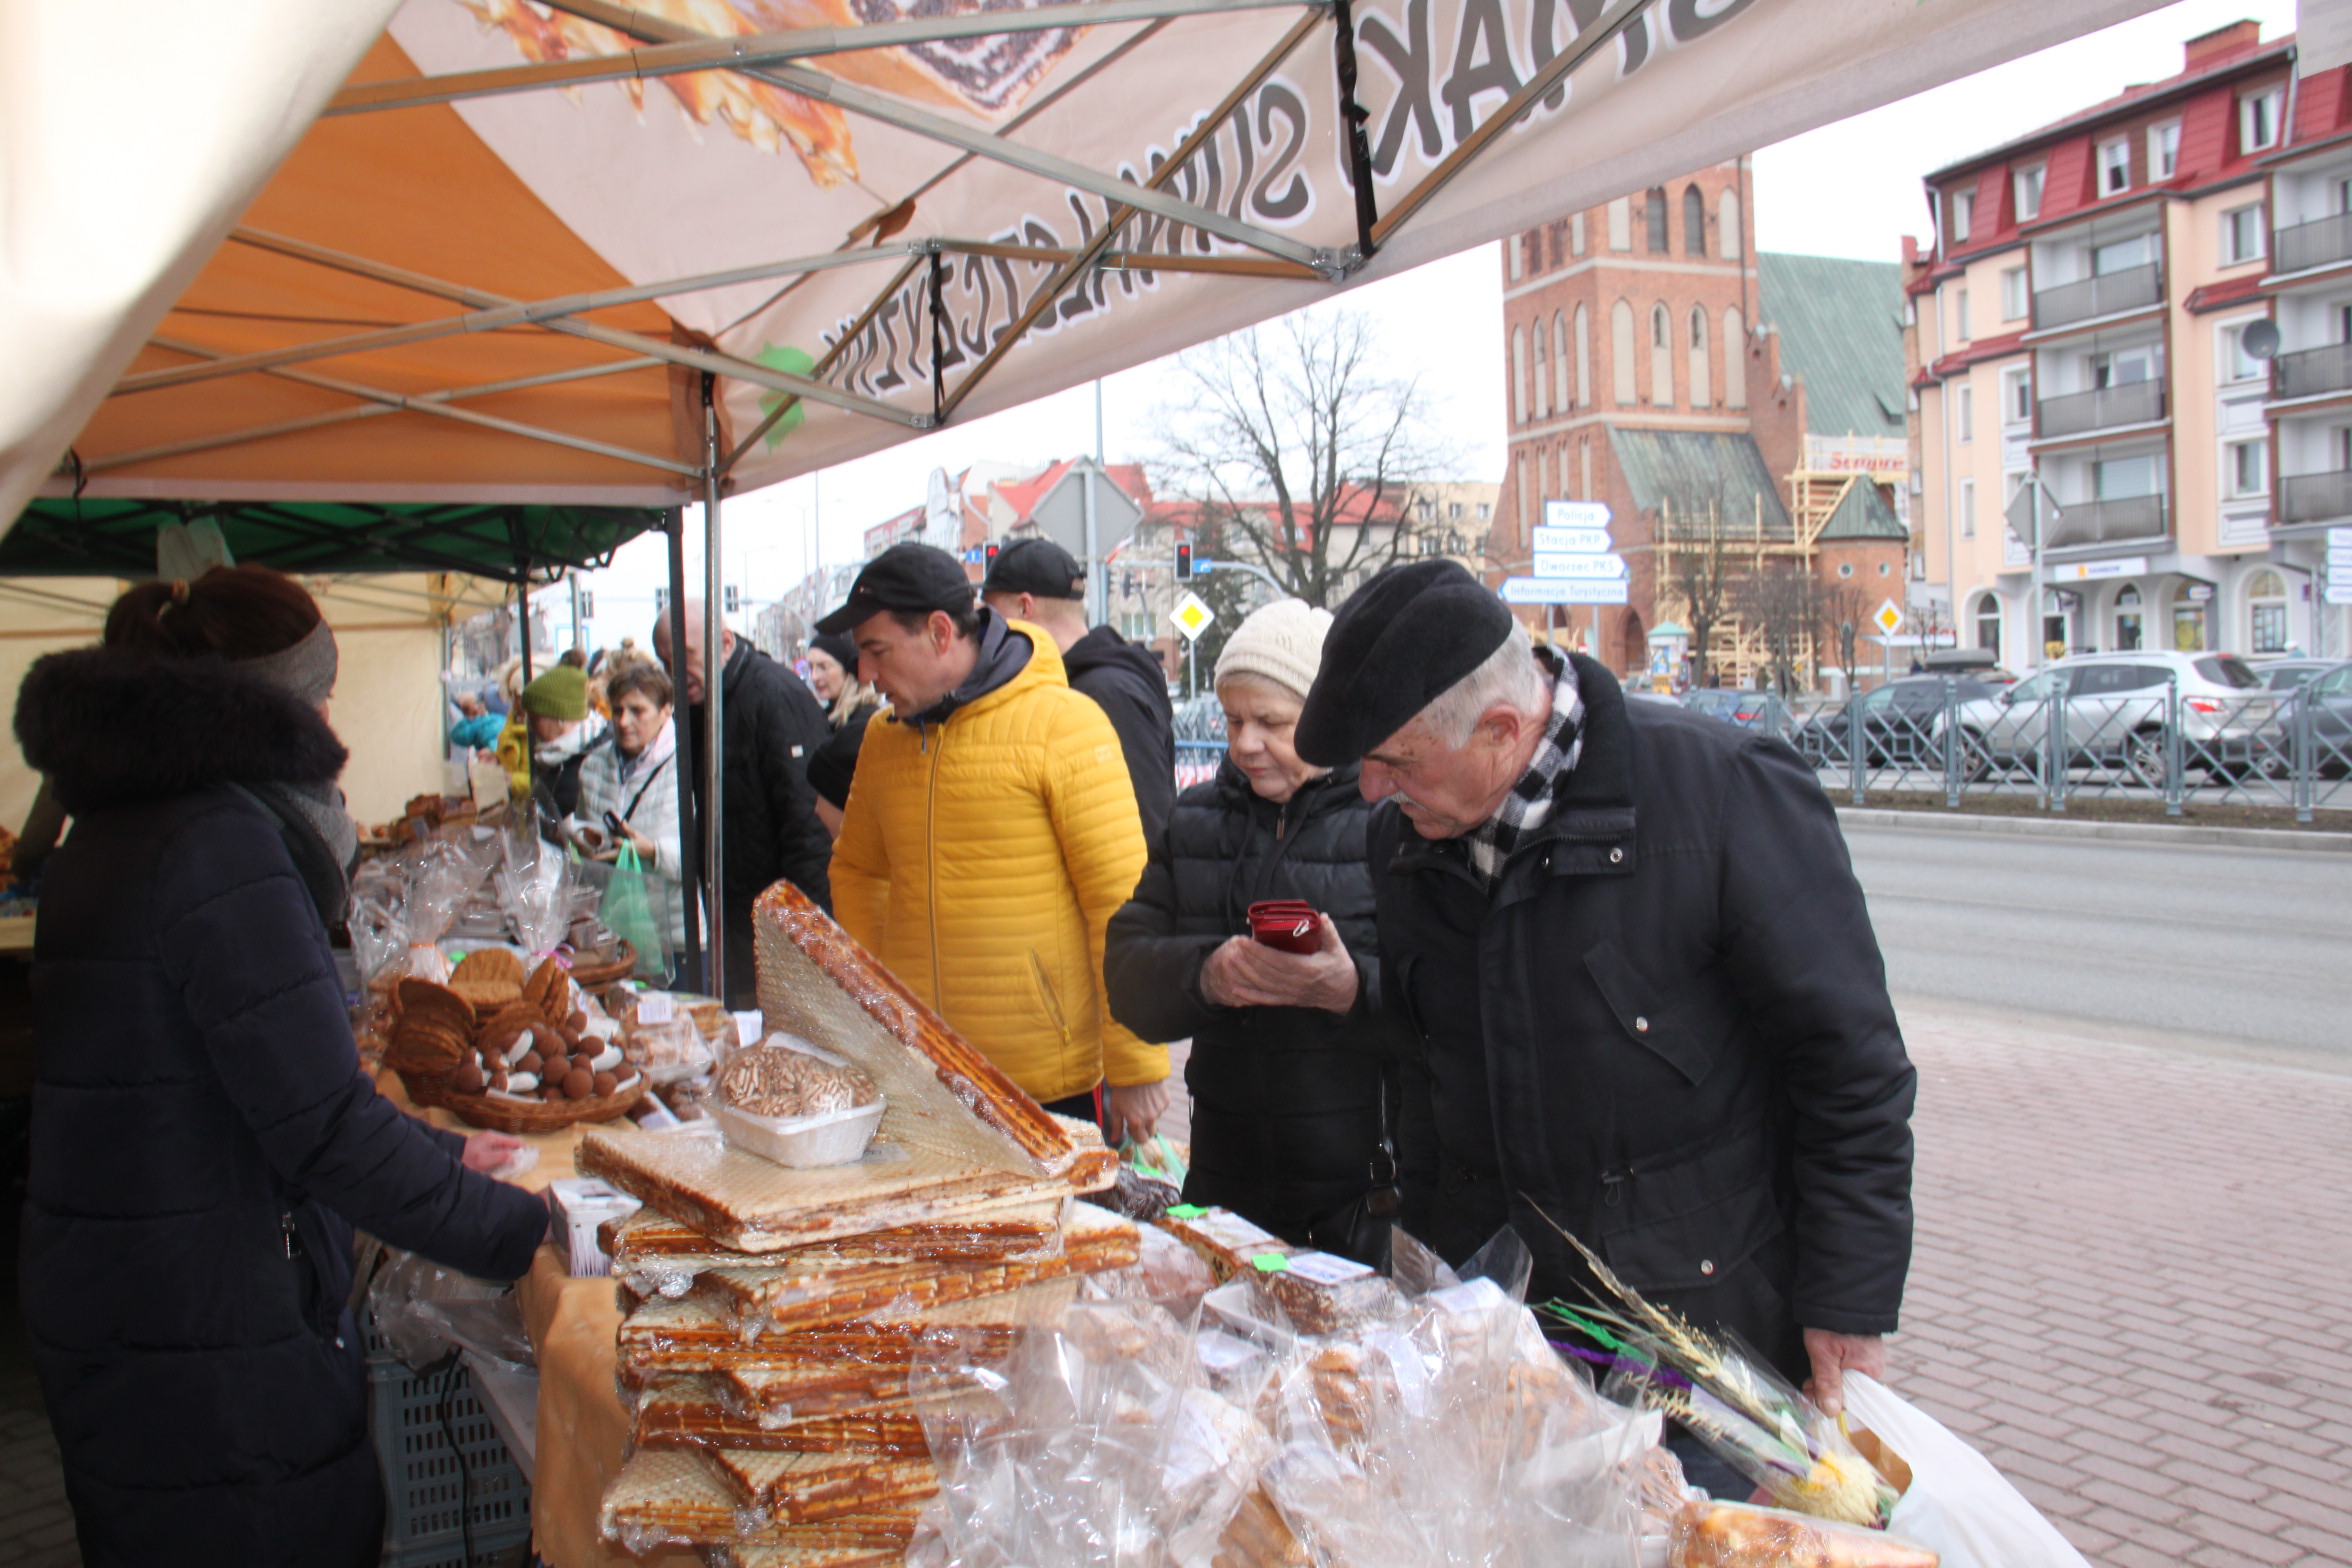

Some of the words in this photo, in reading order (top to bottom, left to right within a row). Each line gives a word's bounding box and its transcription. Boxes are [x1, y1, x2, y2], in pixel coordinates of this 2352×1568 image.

[1557, 508, 1594, 523] Policja
[1539, 533, 1576, 548] Stacja
[1580, 533, 1601, 545] PKP
[1540, 560, 1590, 572] Dworzec
[1593, 560, 1614, 573] PKS
[1510, 585, 1566, 598] Informacja
[1570, 585, 1623, 599] Turystyczna
